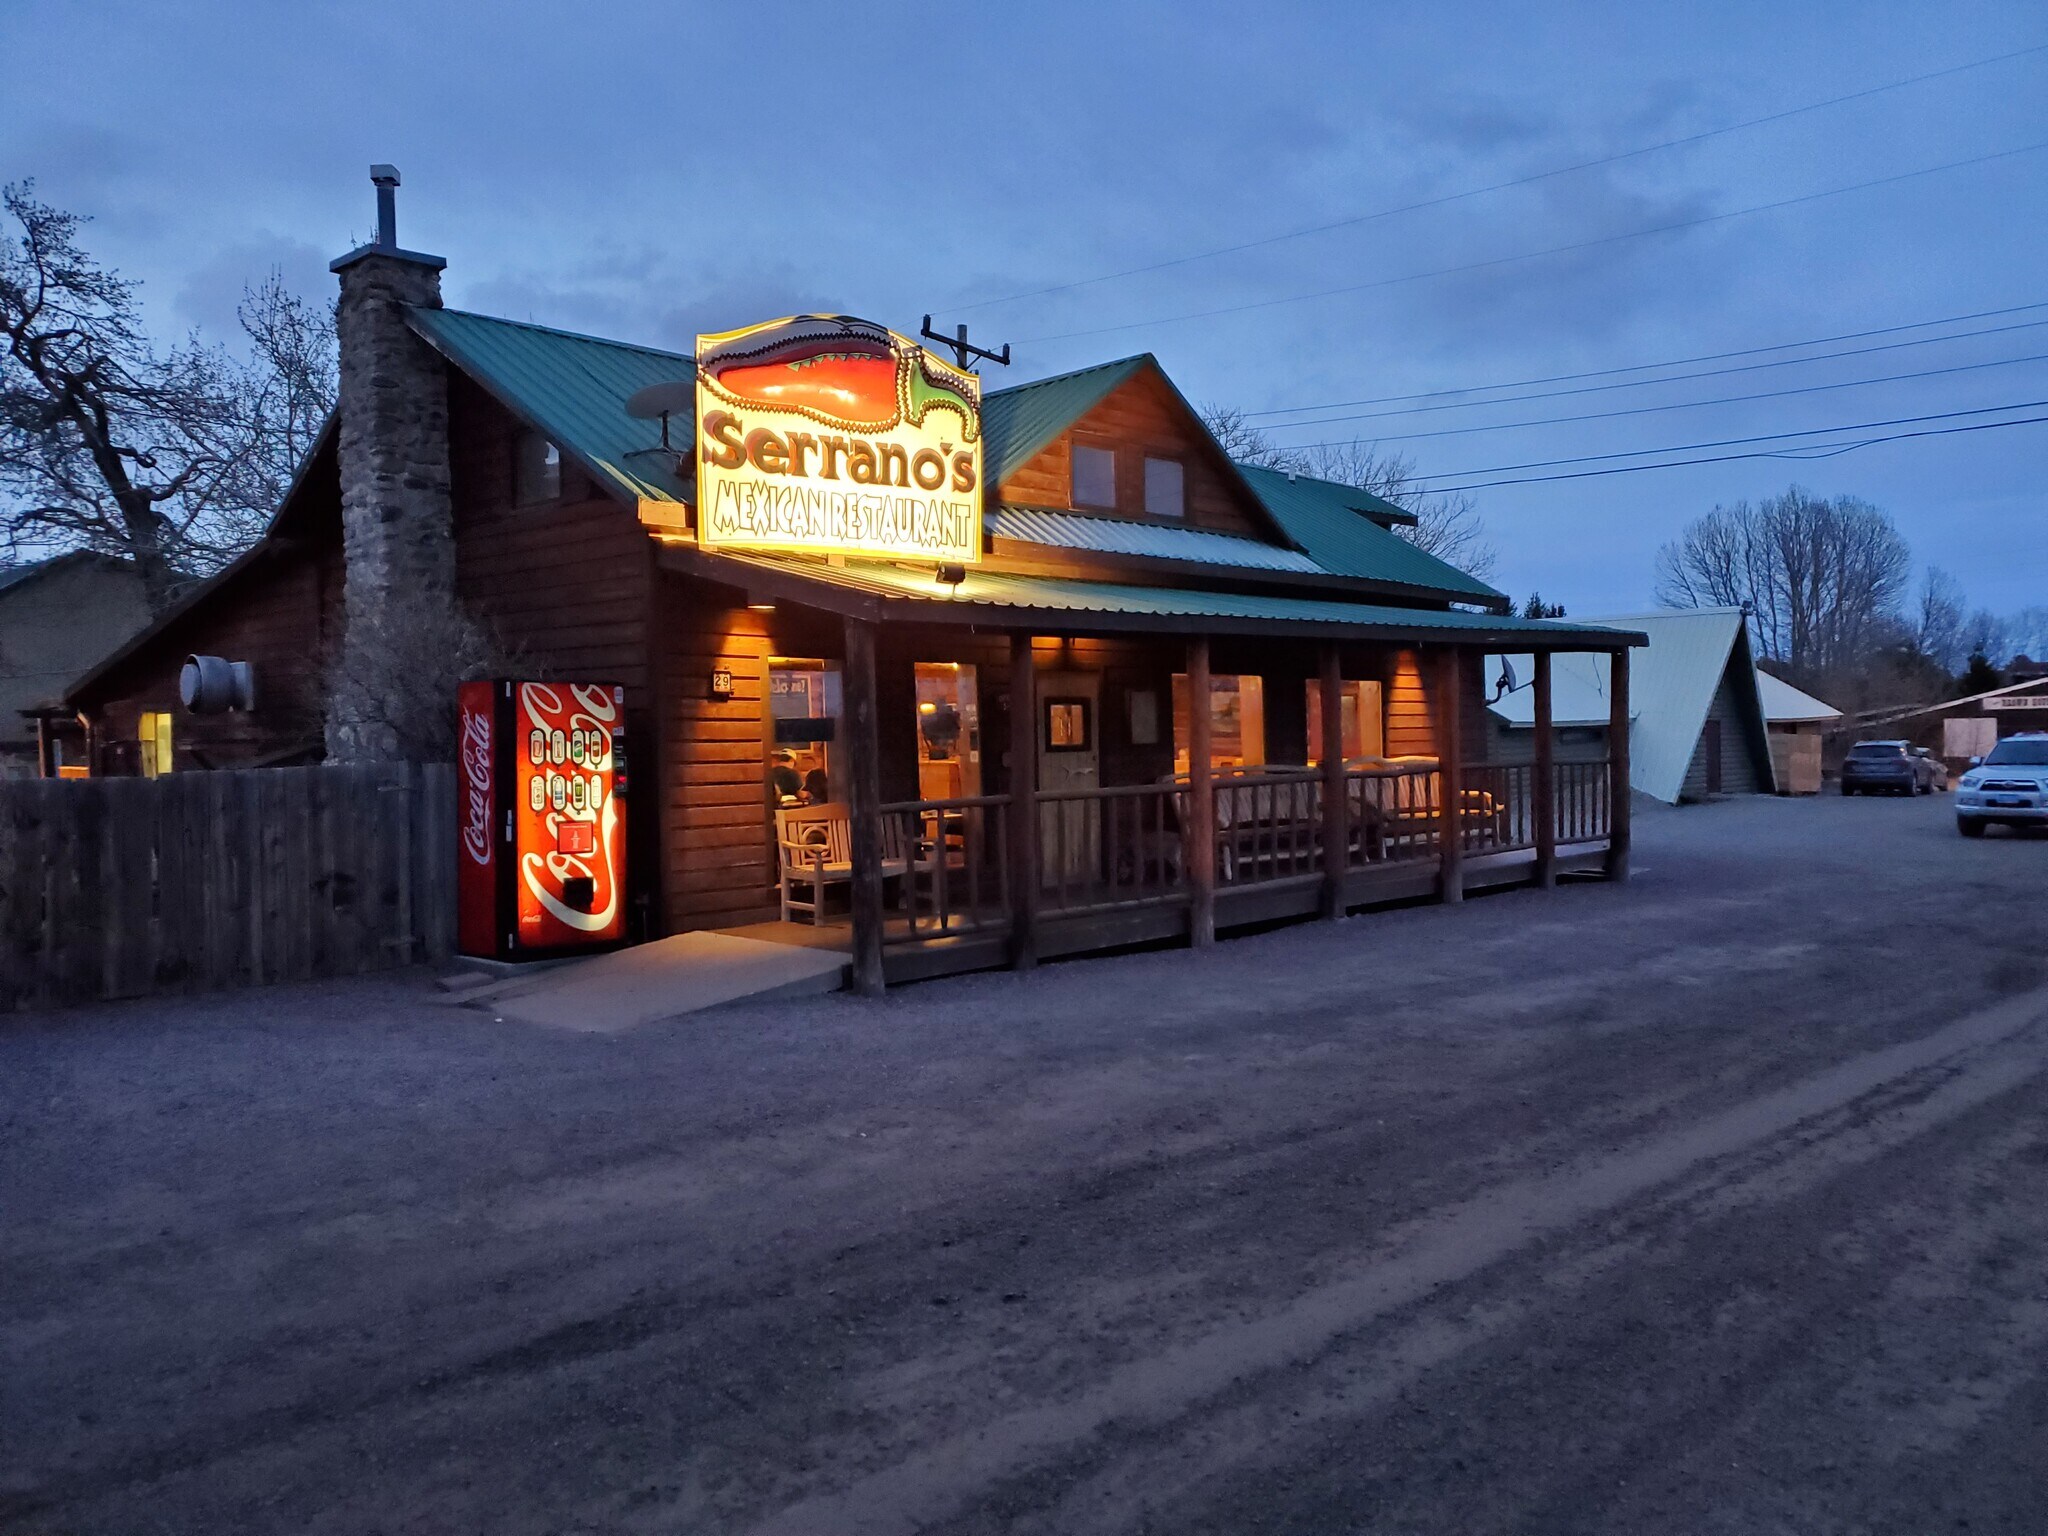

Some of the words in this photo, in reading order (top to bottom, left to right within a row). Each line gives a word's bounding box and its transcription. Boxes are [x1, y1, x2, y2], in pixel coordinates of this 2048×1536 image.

[702, 410, 976, 493] Serrano's
[713, 479, 826, 537] MEXICAN
[831, 491, 971, 548] RESTAURANT
[715, 675, 729, 687] 29
